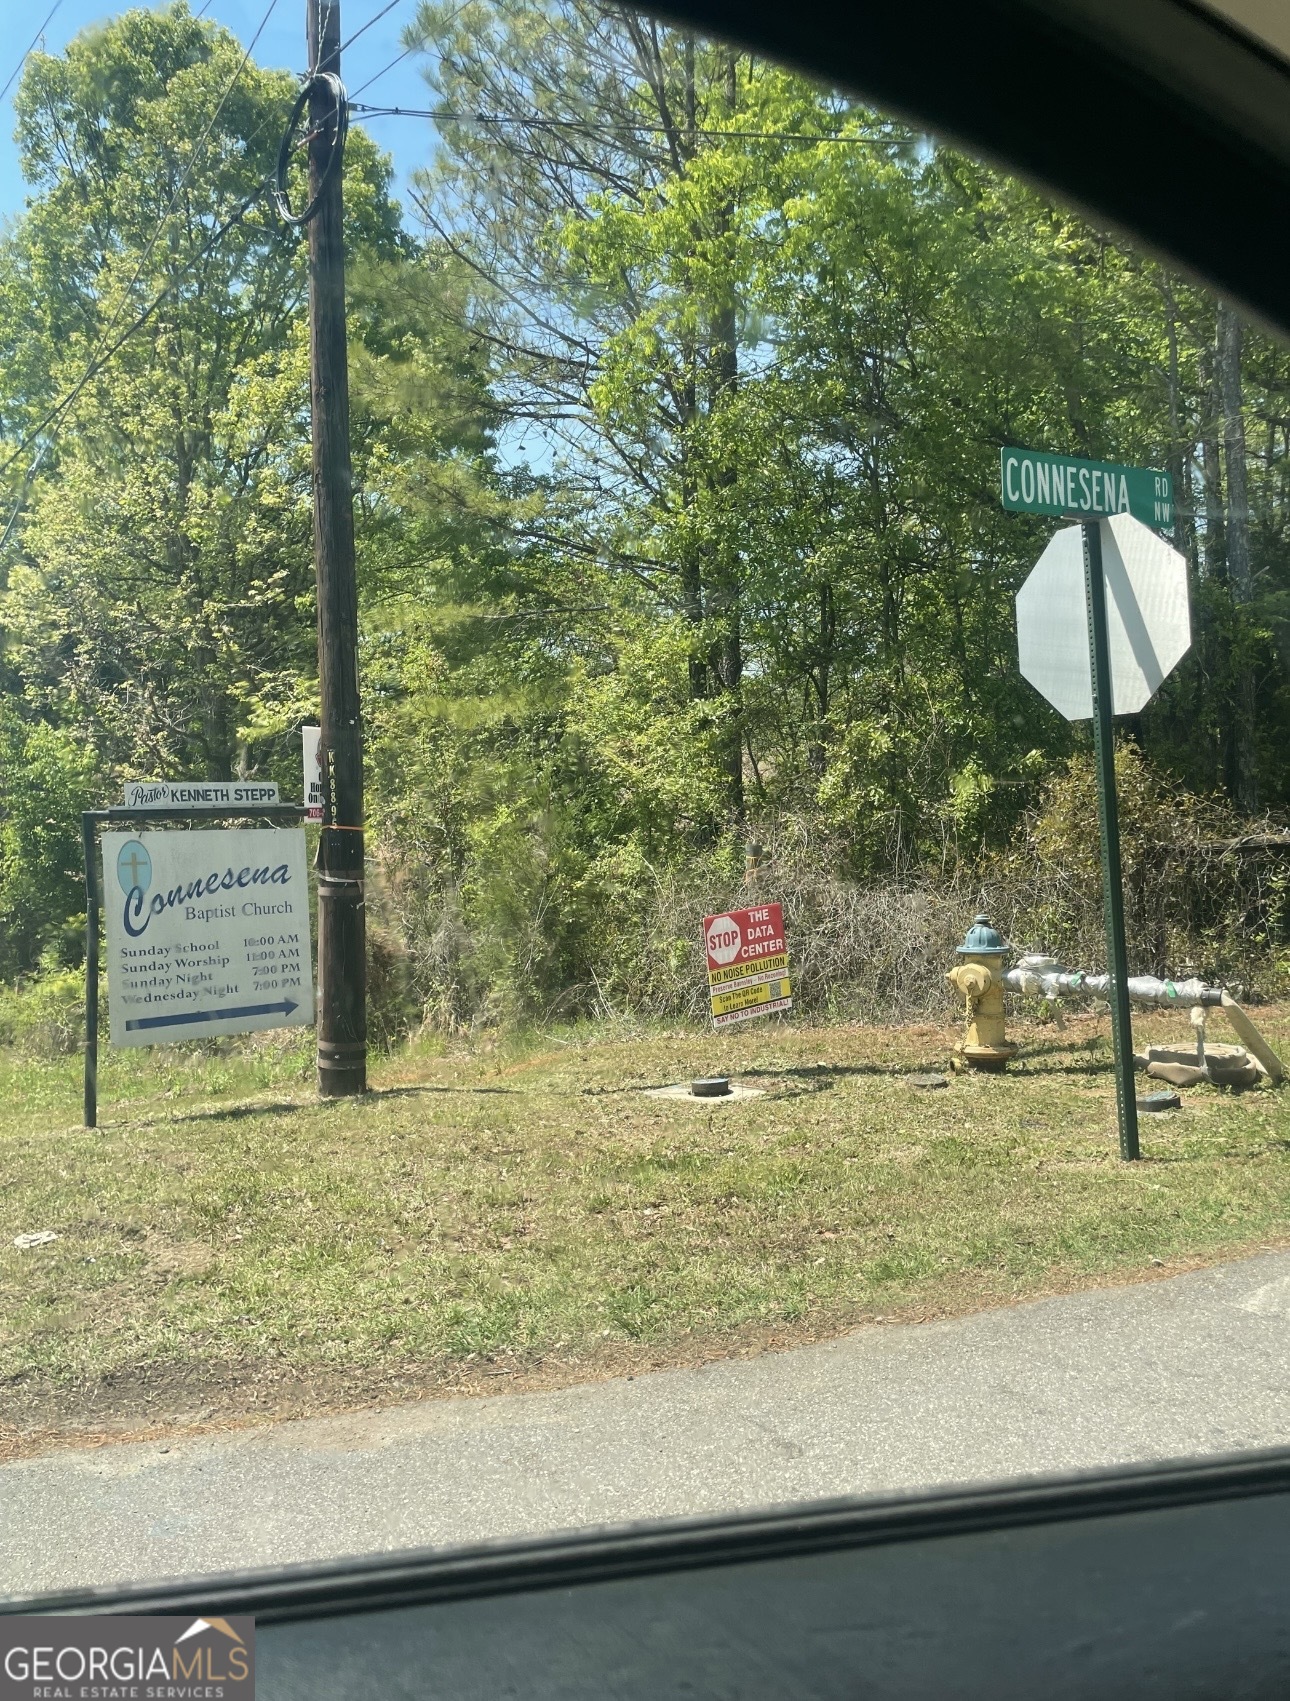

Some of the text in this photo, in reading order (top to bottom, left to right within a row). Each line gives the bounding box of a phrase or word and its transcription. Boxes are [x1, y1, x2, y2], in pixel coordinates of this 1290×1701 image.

[1006, 457, 1130, 513] CONNESENA
[1154, 476, 1168, 498] RD
[1154, 501, 1170, 523] NW
[129, 785, 276, 807] Pastor KENNETH STEPP
[123, 864, 292, 937] Connesena
[185, 901, 293, 923] Baptist Church
[748, 909, 769, 923] THE
[709, 930, 739, 951] STOP
[747, 925, 774, 940] DATA
[121, 934, 299, 958] Sunday School 10:00 AM
[741, 939, 783, 958] CENTER
[121, 948, 300, 974] Sunday Worship 11:00 AM
[711, 956, 785, 983] NO NOISE POLLUTION
[122, 963, 300, 990] Sunday Night 7:00 PM
[121, 977, 301, 1004] Wednesday Night 7:00 PM
[712, 984, 733, 993] Preserve
[719, 995, 731, 1004] Scan
[732, 991, 742, 999] The
[750, 986, 763, 995] Code
[716, 1000, 789, 1024] SAY NO TO INDUSTRIAL!
[730, 1000, 744, 1010] Learn
[744, 996, 759, 1006] More!
